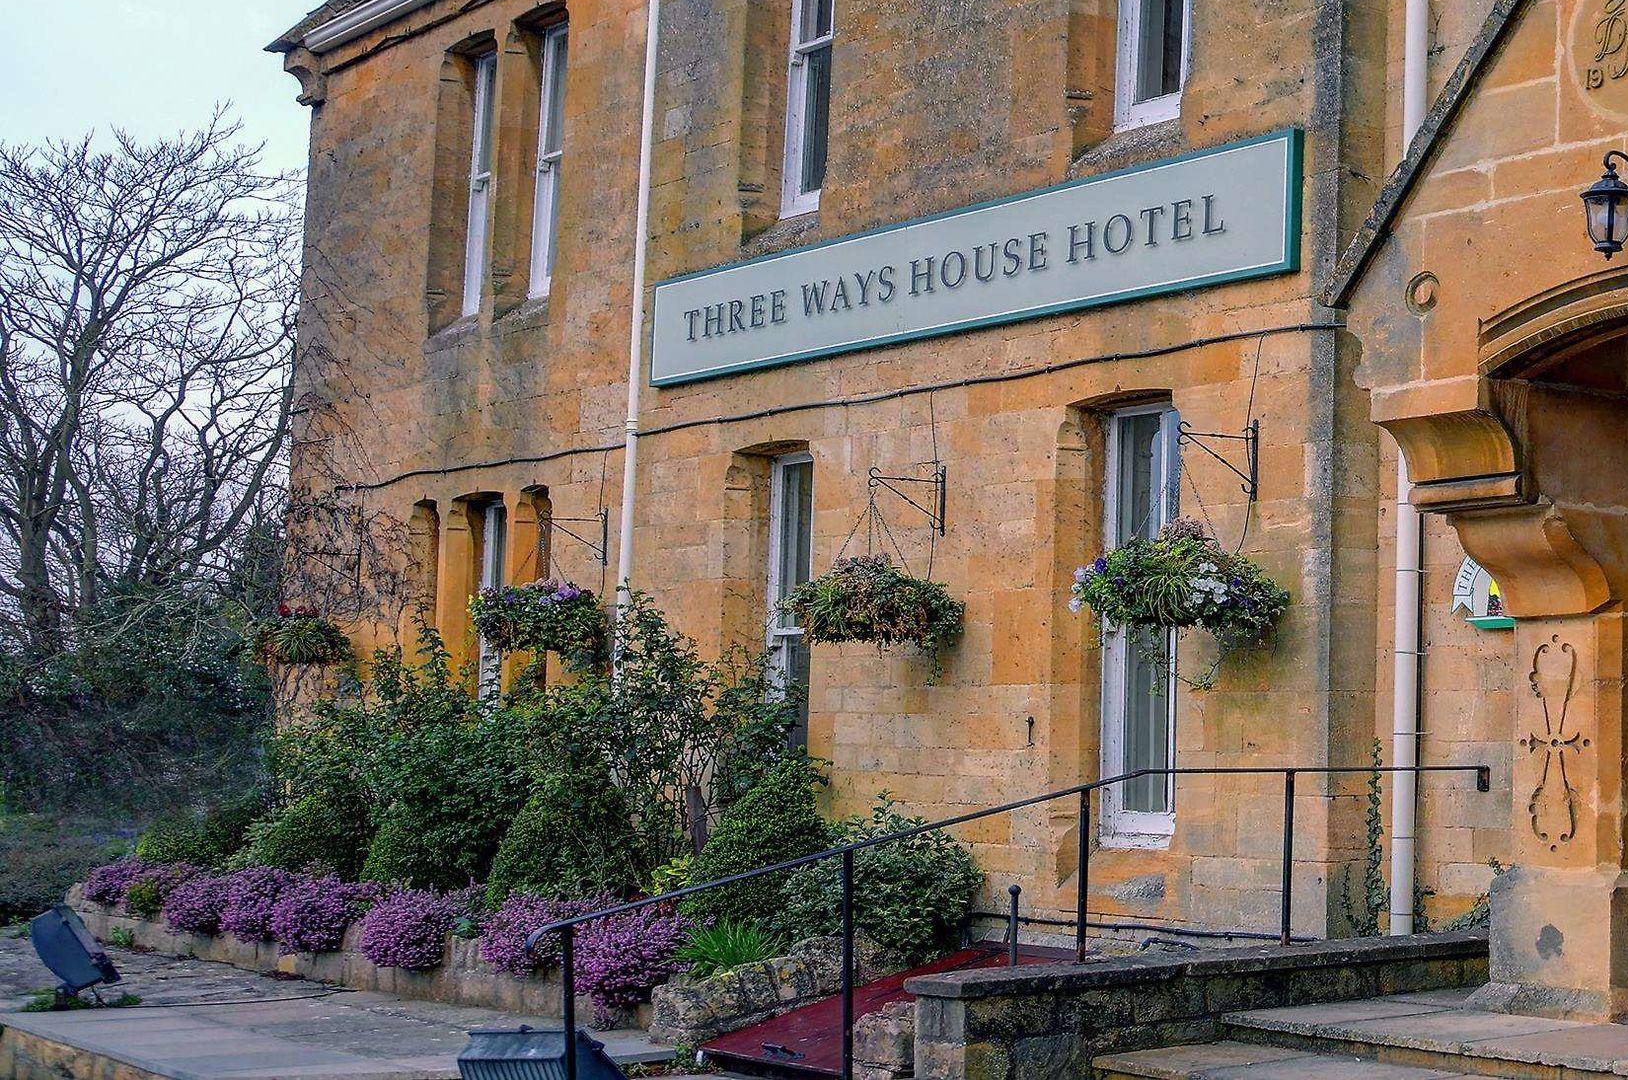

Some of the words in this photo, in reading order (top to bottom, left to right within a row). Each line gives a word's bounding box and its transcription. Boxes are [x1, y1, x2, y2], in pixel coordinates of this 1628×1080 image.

[683, 289, 787, 342] THREE
[801, 265, 896, 317] WAYS
[908, 232, 1049, 296] HOUSE
[1066, 194, 1226, 264] HOTEL
[1457, 559, 1478, 591] THE
